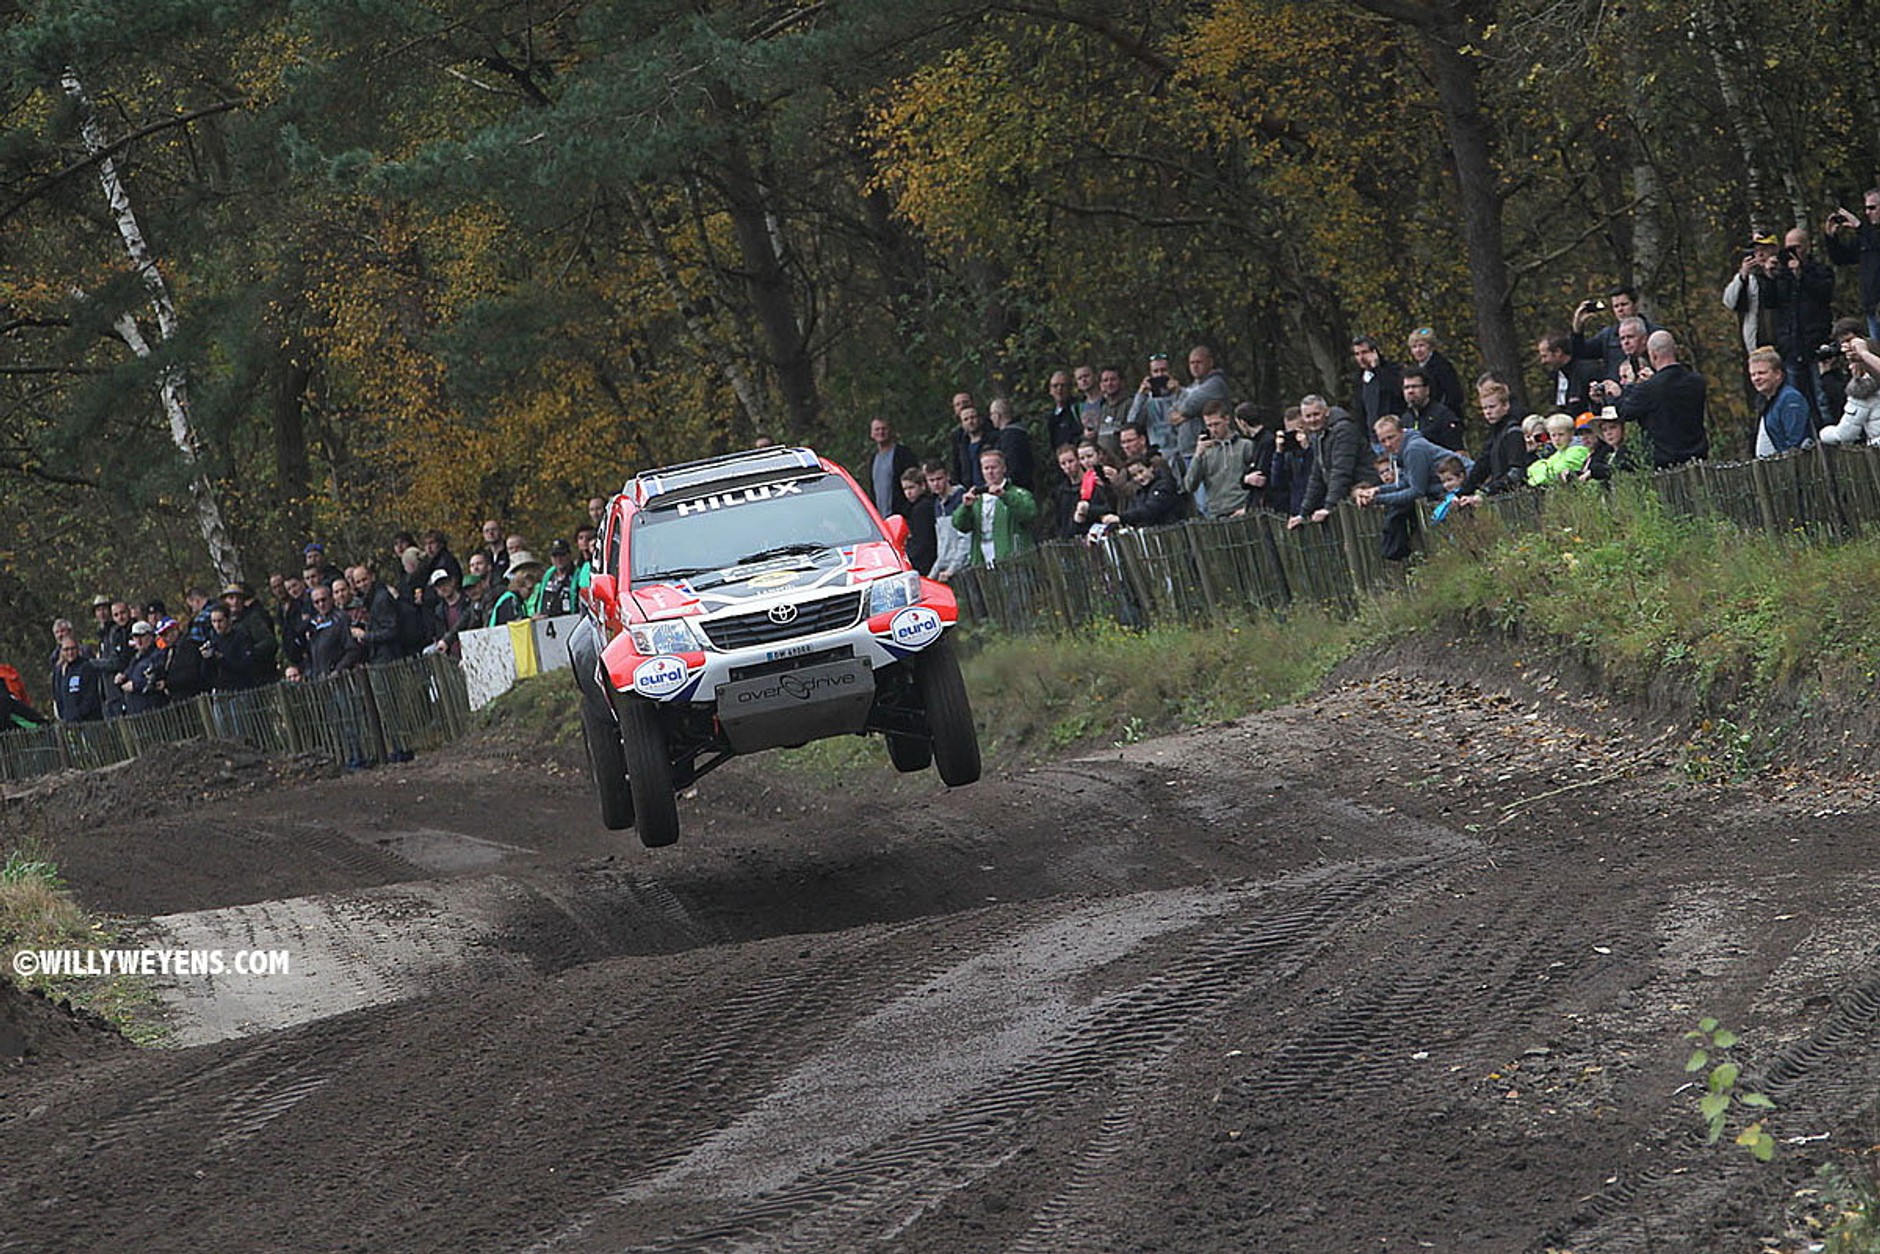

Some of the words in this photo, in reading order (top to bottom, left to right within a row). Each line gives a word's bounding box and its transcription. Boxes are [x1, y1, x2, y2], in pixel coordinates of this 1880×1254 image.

[676, 481, 802, 517] HILUX
[546, 621, 557, 640] 4
[898, 616, 937, 638] eurol
[640, 667, 682, 686] eurol
